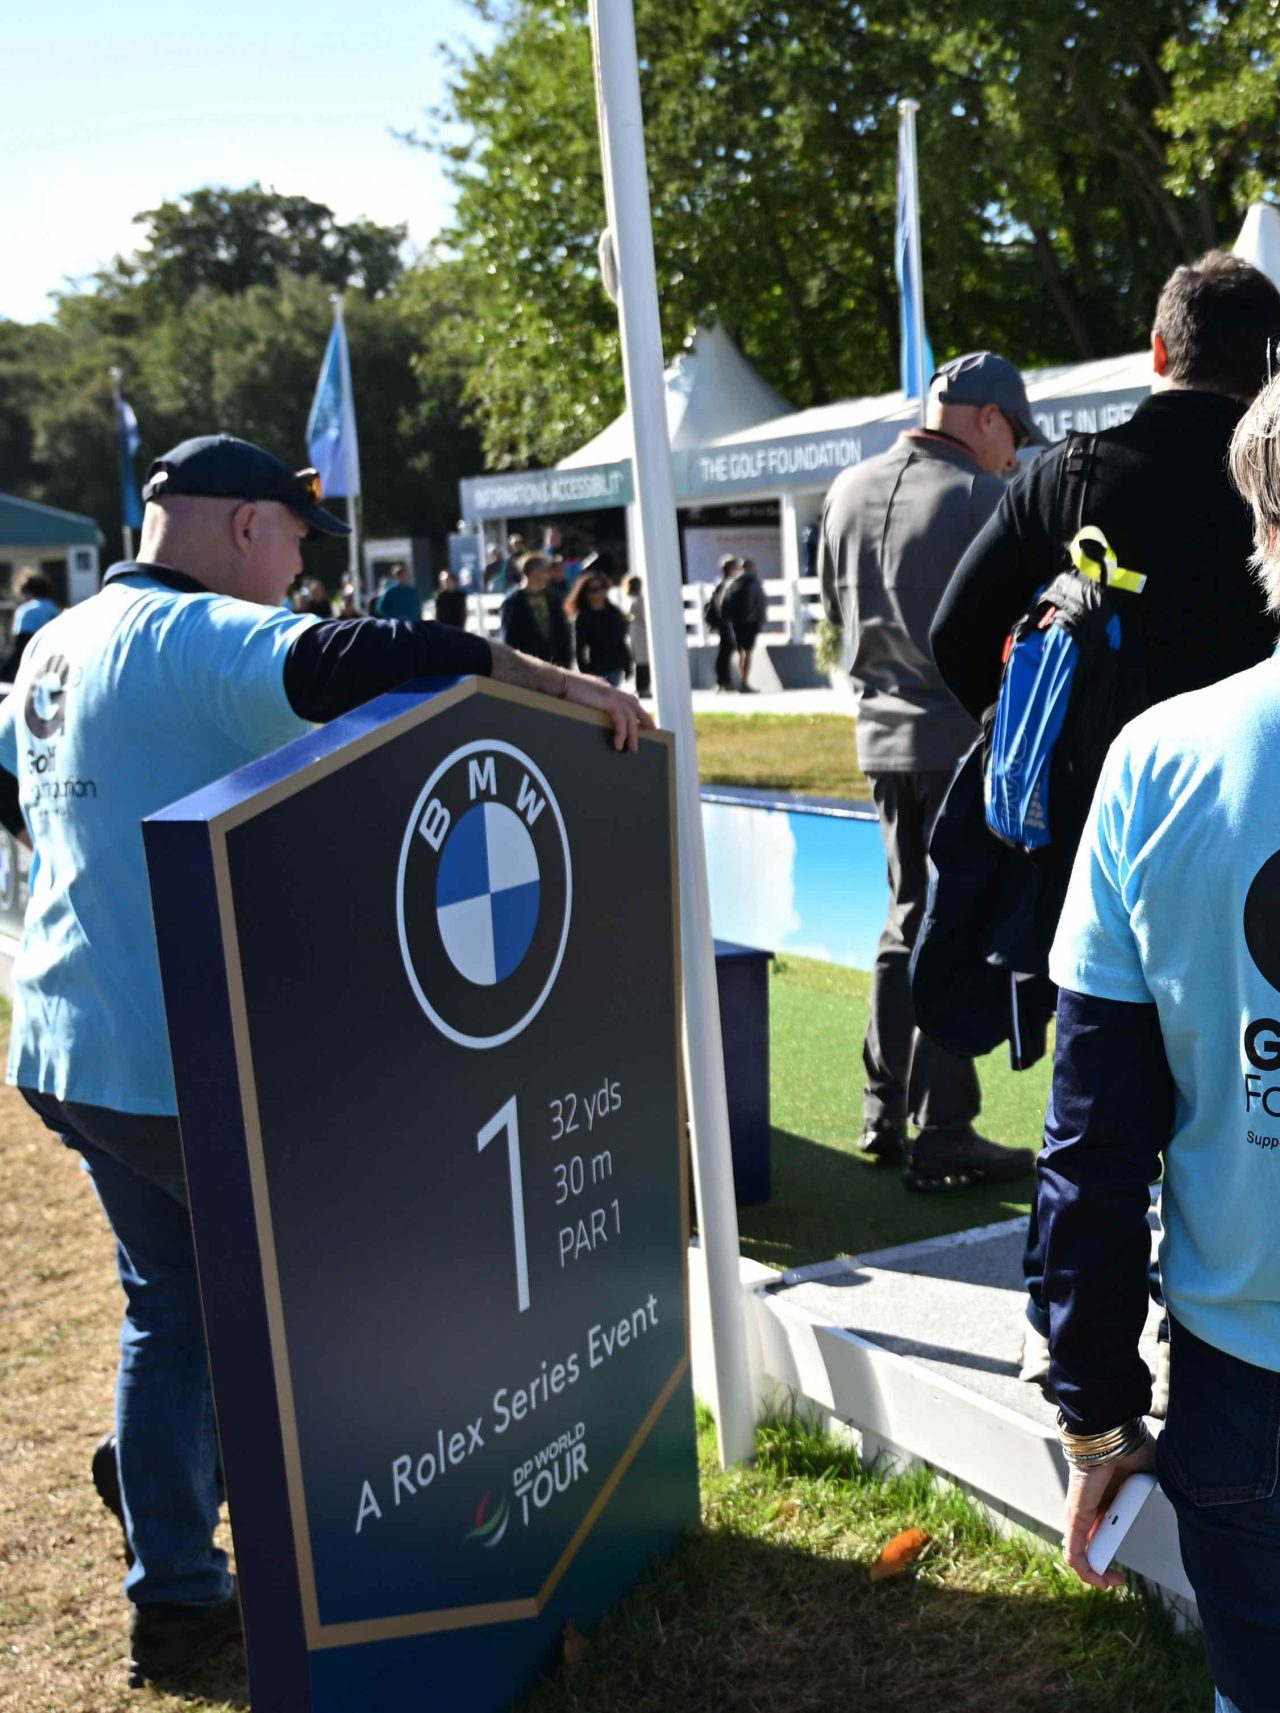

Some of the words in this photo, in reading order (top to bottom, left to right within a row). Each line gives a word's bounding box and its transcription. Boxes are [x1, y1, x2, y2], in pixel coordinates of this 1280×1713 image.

[1033, 412, 1072, 443] OLF
[1075, 407, 1097, 434] IN
[1100, 402, 1138, 431] IRE
[700, 453, 727, 482] THE
[729, 450, 765, 480] GOLF
[768, 438, 862, 475] FOUNDATION
[419, 756, 547, 852] BMW
[550, 1092, 579, 1140] 32
[584, 1077, 622, 1131] yds
[476, 1093, 531, 1313] 1
[553, 1155, 584, 1206] 30
[591, 1149, 613, 1184] m
[558, 1208, 608, 1269] PAR
[611, 1198, 622, 1235] 1
[355, 1479, 382, 1534] A
[391, 1416, 485, 1506] Rolex
[493, 1352, 580, 1434] Series
[587, 1294, 659, 1369] Event
[513, 1459, 533, 1487] DP
[534, 1422, 586, 1469] WORLD
[515, 1442, 589, 1527] TOUR
